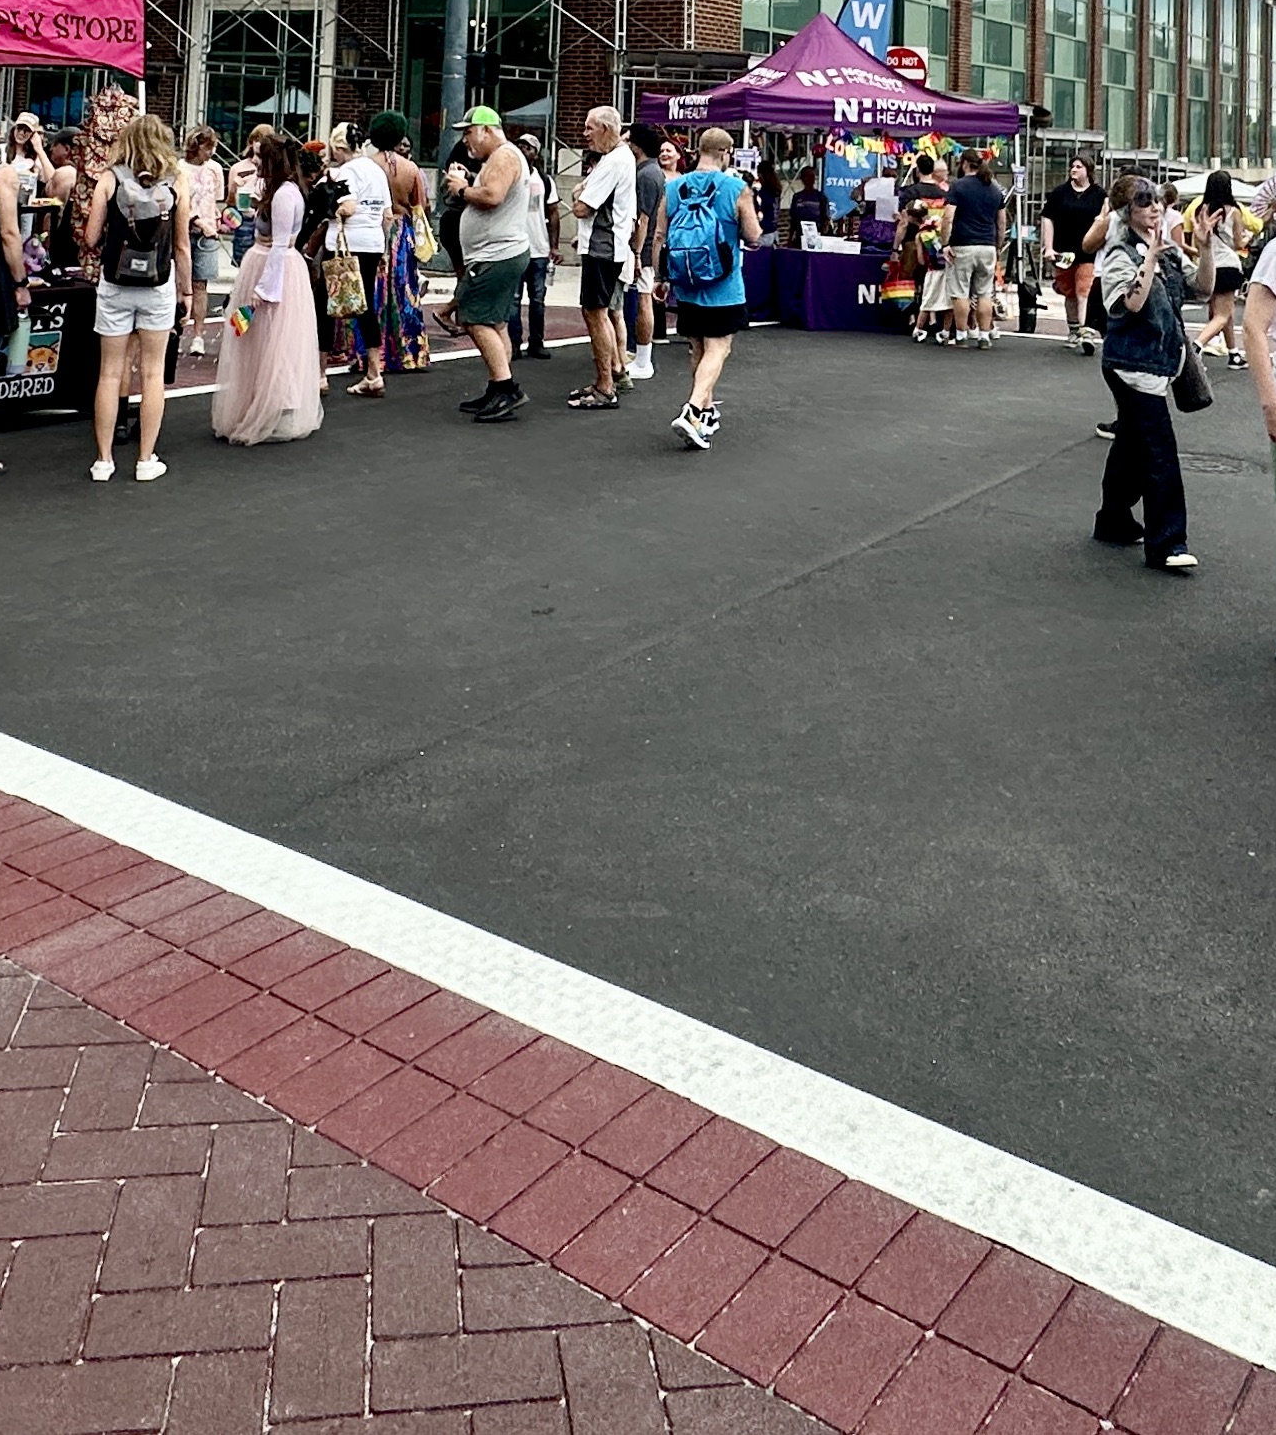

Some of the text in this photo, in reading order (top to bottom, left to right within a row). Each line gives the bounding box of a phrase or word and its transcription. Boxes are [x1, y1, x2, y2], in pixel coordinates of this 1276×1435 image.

[53, 12, 137, 43] STORE
[886, 57, 919, 66] DO NOT
[875, 98, 936, 114] NOVANT
[876, 111, 932, 127] HEALTH
[826, 177, 862, 187] STATIO
